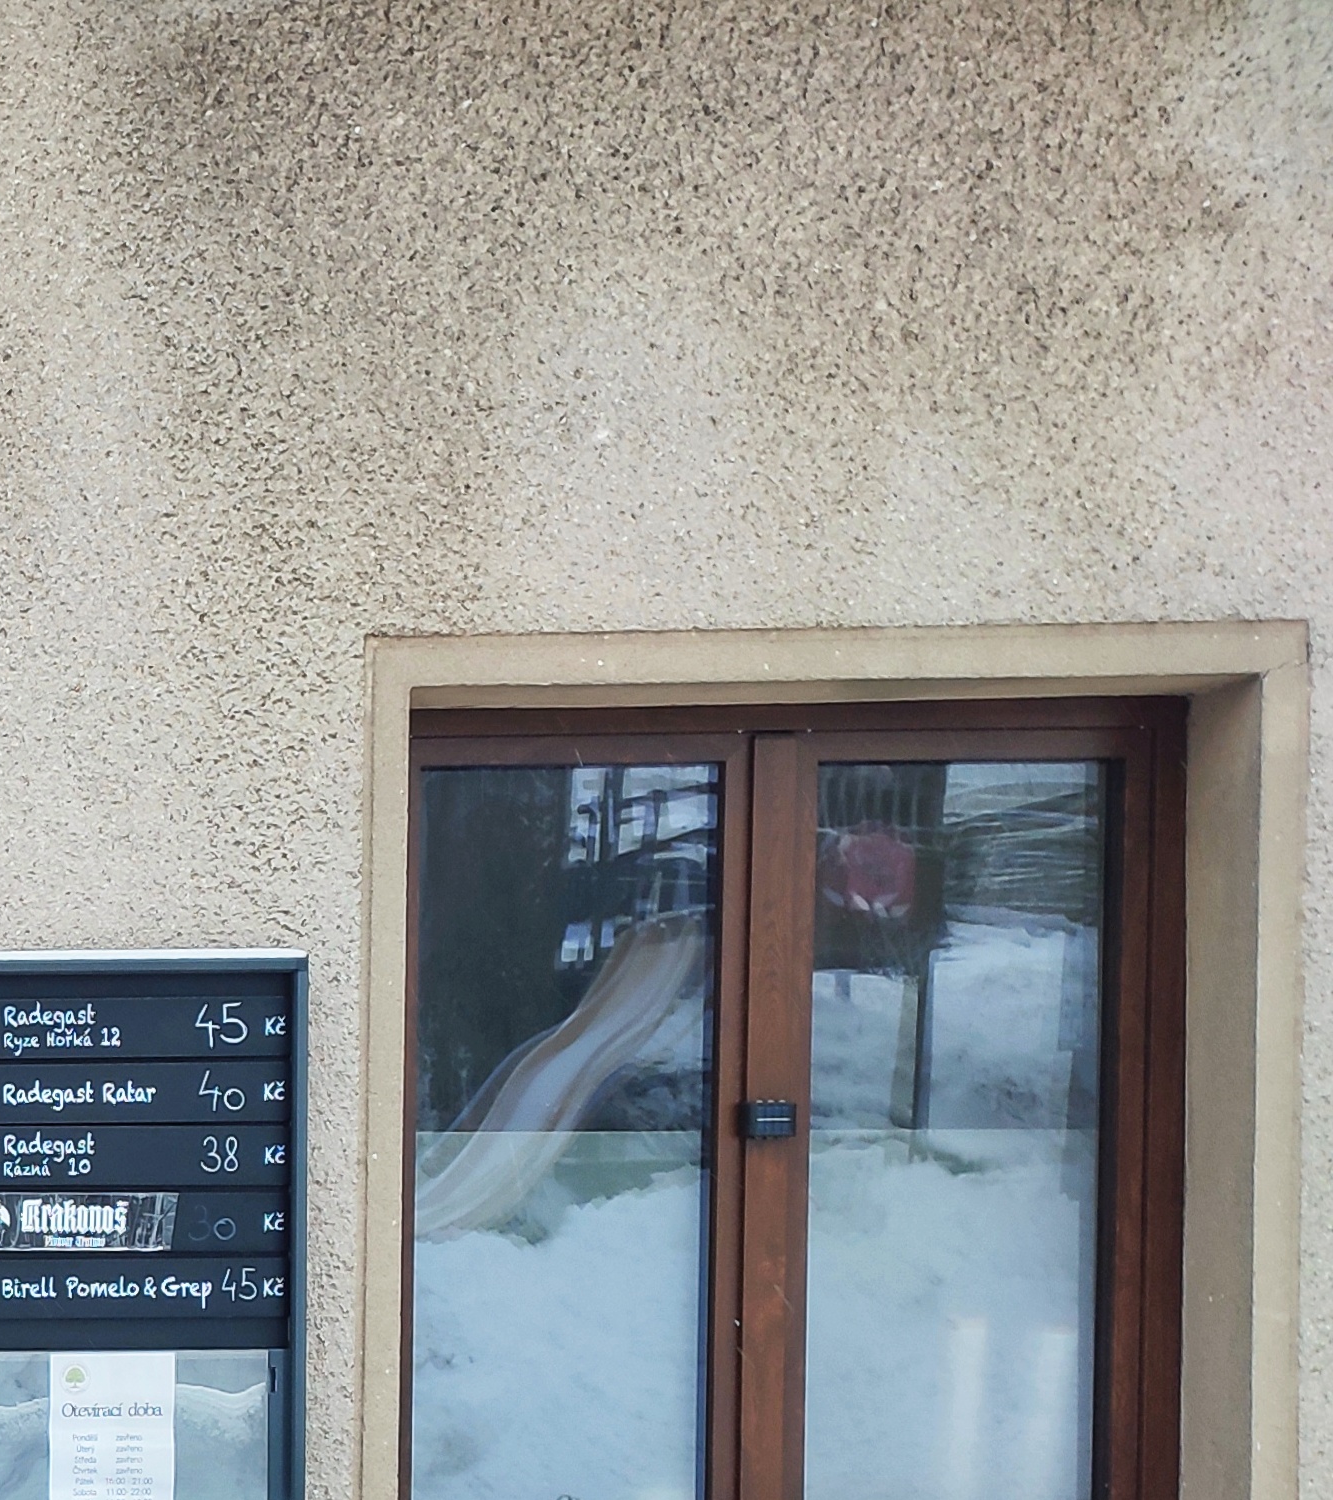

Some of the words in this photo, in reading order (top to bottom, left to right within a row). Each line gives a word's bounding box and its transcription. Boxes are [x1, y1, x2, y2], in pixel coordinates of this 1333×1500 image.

[3, 1001, 96, 1033] Radegast
[195, 1001, 248, 1048] 45
[265, 1016, 286, 1036] Kč
[3, 1032, 40, 1056] Ryze
[46, 1028, 93, 1048] Hořká
[100, 1027, 121, 1047] 12
[2, 1080, 95, 1111] Radegast
[102, 1080, 157, 1105] Ratar
[198, 1070, 245, 1112] 40
[263, 1080, 285, 1101] Kč
[3, 1131, 95, 1163] Radegast
[200, 1136, 239, 1173] 38
[264, 1145, 285, 1165] Kč
[3, 1157, 51, 1178] Rázná
[68, 1158, 91, 1176] 10
[263, 1212, 284, 1233] Kč
[1, 1276, 57, 1299] Birell
[66, 1275, 140, 1300] Pomelo
[143, 1277, 158, 1299] &
[161, 1277, 213, 1310] Grep
[221, 1267, 257, 1302] 45
[263, 1277, 284, 1298] Kč
[61, 1402, 123, 1418] Otevírací
[128, 1402, 164, 1417] doba
